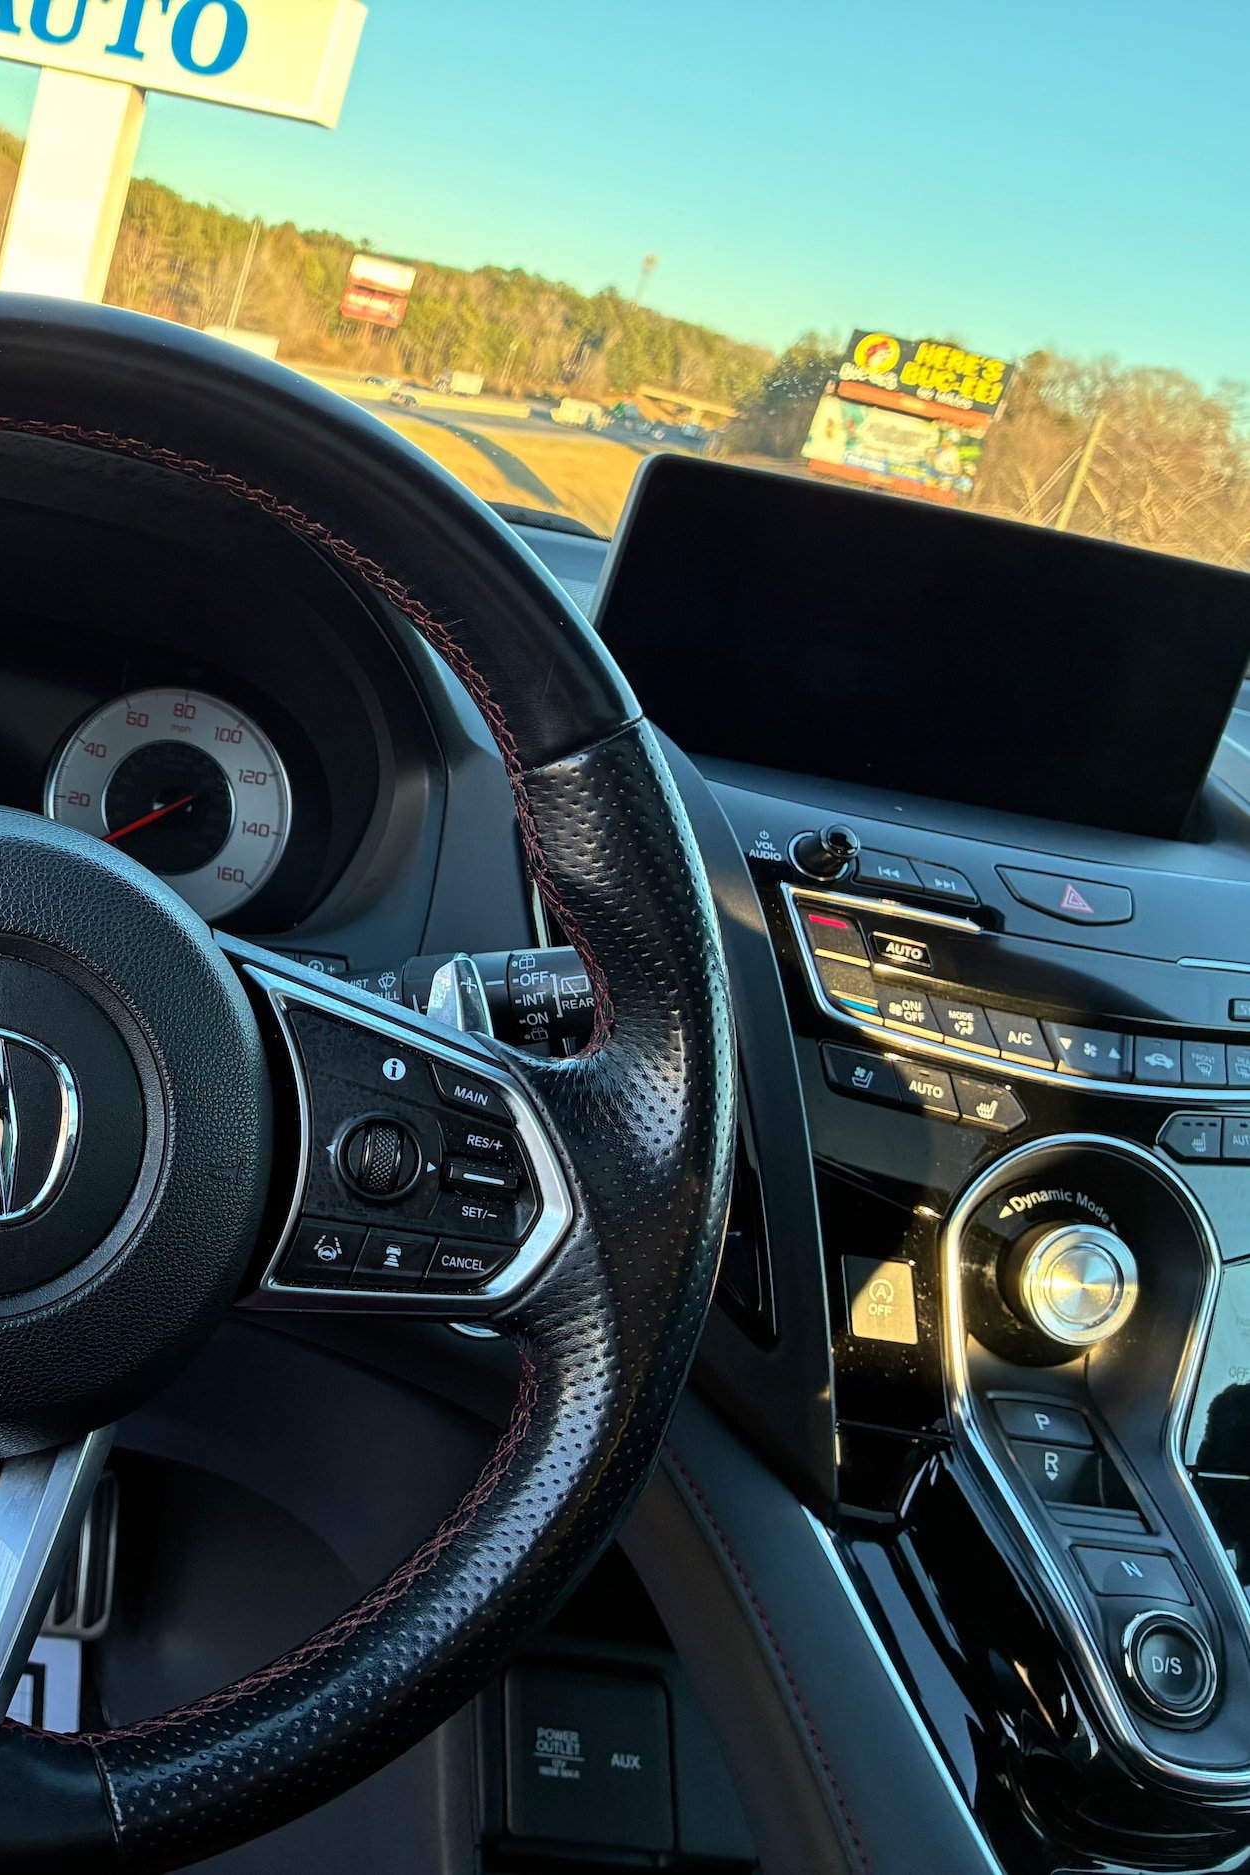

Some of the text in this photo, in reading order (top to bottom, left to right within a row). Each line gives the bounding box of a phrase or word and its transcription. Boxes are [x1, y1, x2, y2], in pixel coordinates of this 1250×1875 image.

[125, 711, 149, 728] 60
[173, 703, 196, 720] 80
[170, 723, 192, 734] mph
[214, 727, 242, 744] 100
[84, 742, 107, 759] 40
[238, 769, 267, 786] 120
[67, 791, 90, 808] 20
[242, 821, 270, 838] 140
[754, 840, 776, 851] VOL
[749, 849, 782, 862] AUDIO
[216, 866, 244, 883] 160
[885, 941, 923, 960] AUTO
[520, 971, 549, 987] OFF
[522, 991, 546, 1007] INT
[561, 997, 595, 1010] REAR
[526, 1012, 549, 1026] ON
[903, 1011, 925, 1023] OFF
[948, 1009, 975, 1022] MODE
[1007, 1030, 1033, 1046] A/C
[1191, 1052, 1215, 1064] FRONT
[453, 1085, 489, 1106] MAIN
[908, 1080, 944, 1099] AUTO
[466, 1134, 503, 1151] RES/+
[1233, 1134, 1250, 1146] AUT
[1008, 1187, 1111, 1224] Dynamic Mode
[441, 1254, 485, 1271] CANCEL
[868, 1303, 892, 1317] OFF
[1034, 1413, 1049, 1430] P
[1044, 1451, 1059, 1471] R
[1120, 1560, 1143, 1578] N
[1151, 1655, 1183, 1675] D/S
[536, 1727, 579, 1742] POWER
[535, 1740, 580, 1755] OUTLET
[610, 1753, 641, 1770] AUX
